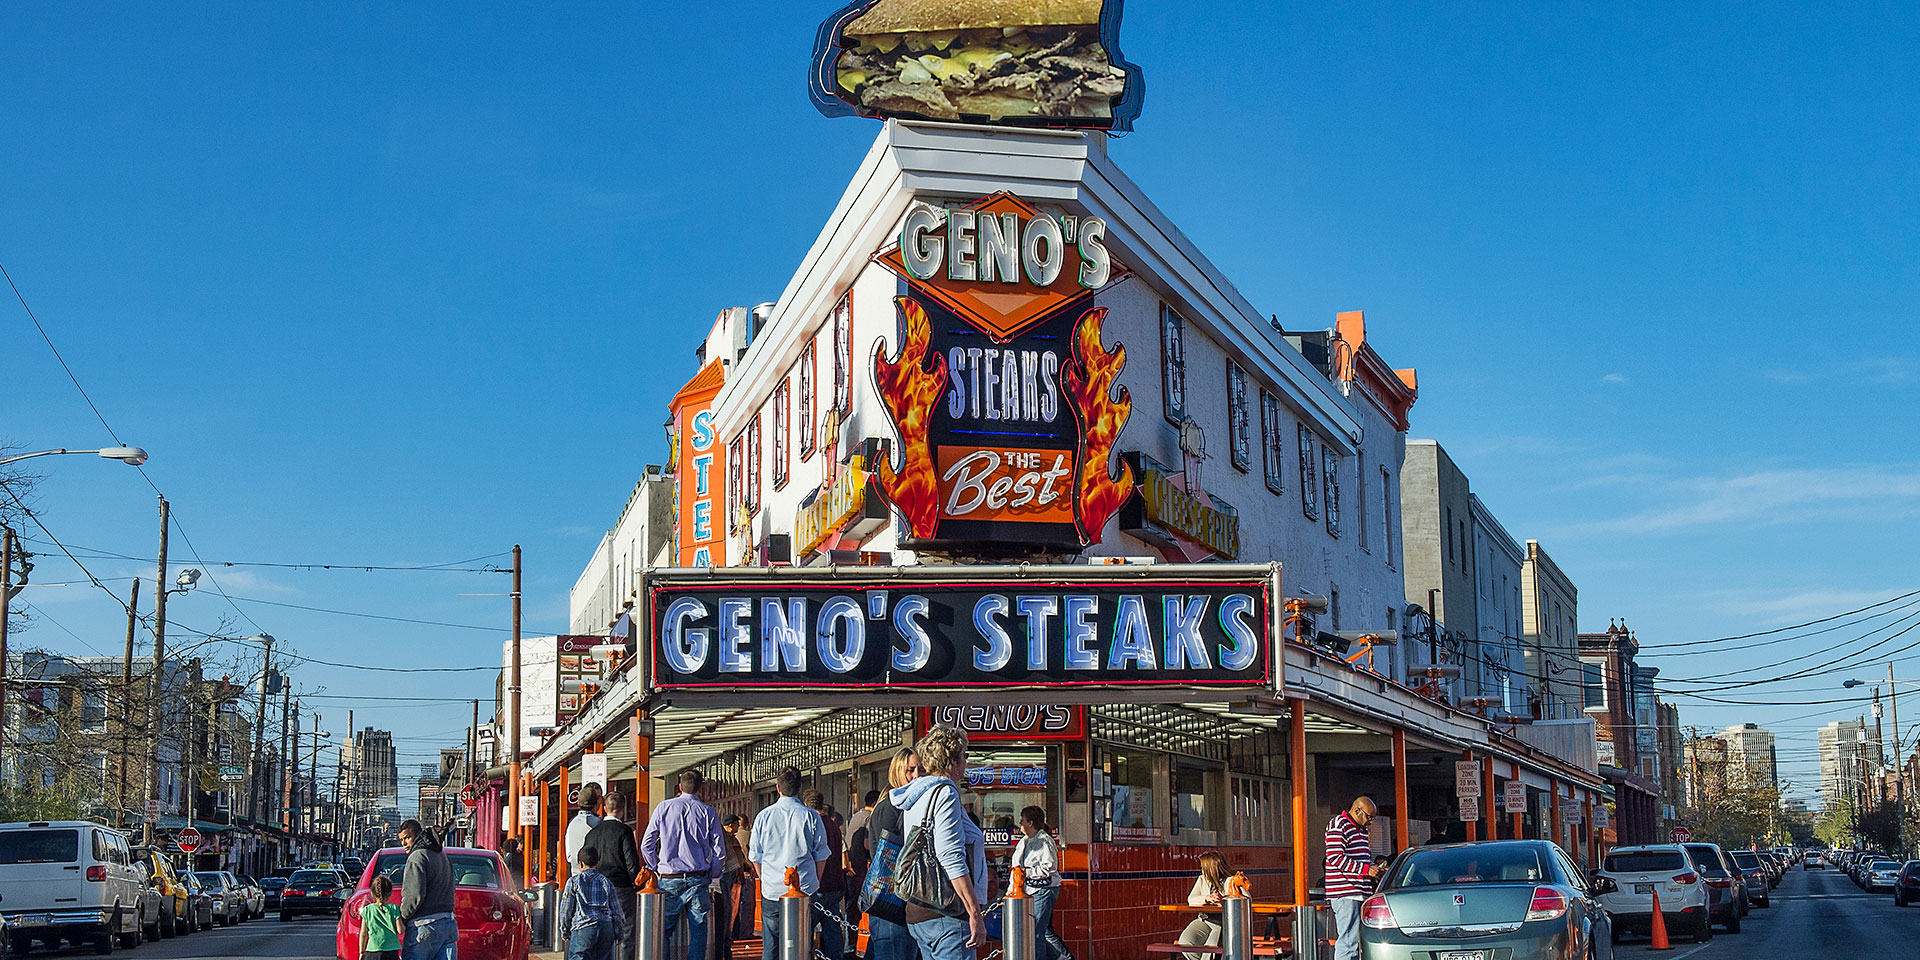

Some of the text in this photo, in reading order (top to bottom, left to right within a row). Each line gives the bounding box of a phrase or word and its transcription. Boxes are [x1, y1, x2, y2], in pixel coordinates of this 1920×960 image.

[901, 205, 1111, 289] GENO'S
[948, 347, 1058, 421] STEAKS
[943, 449, 1071, 516] Best
[1004, 451, 1041, 469] THE
[1154, 471, 1239, 559] CHEESE FRIES
[661, 589, 1259, 674] GENO'S STEAKS
[934, 704, 1071, 731] GENO'S
[179, 835, 199, 845] STOP
[1670, 834, 1690, 842] STOP
